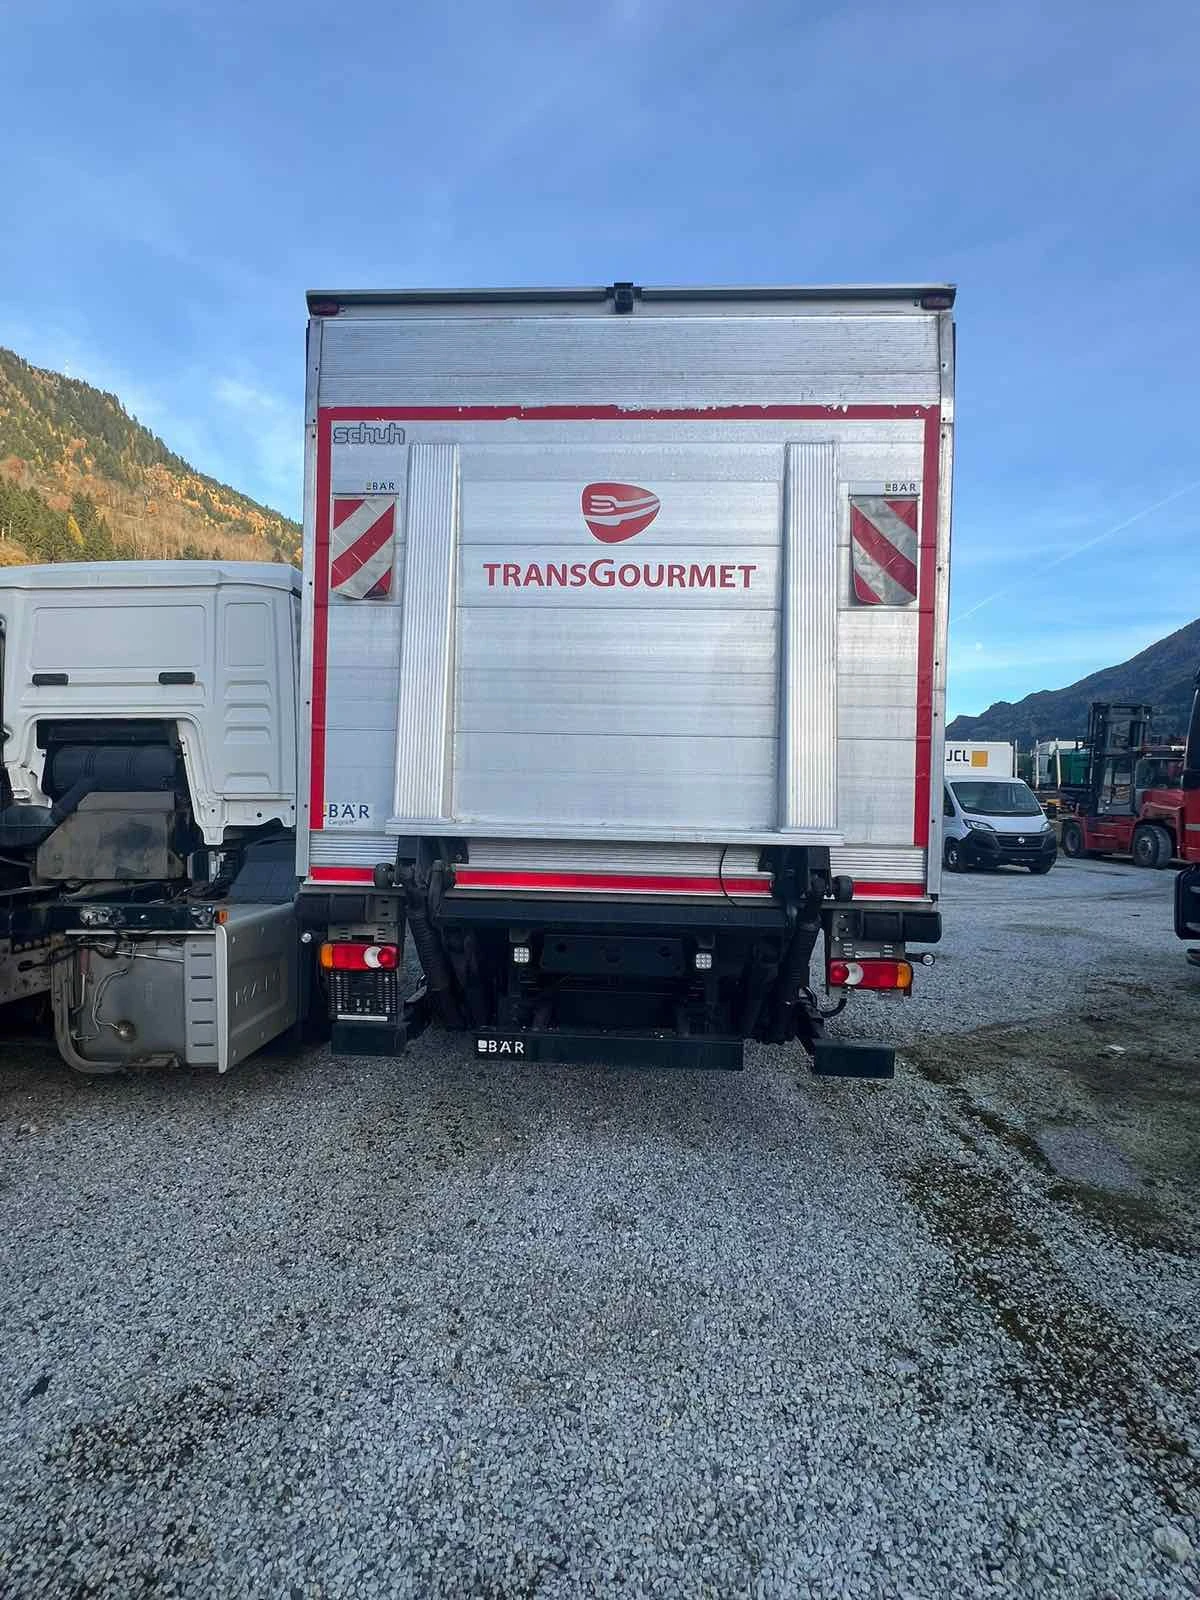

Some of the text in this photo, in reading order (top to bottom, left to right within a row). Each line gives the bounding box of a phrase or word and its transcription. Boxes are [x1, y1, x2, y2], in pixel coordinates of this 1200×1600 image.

[333, 422, 406, 445] schuh
[329, 804, 370, 819] BÄR
[488, 1040, 525, 1054] BÄR
